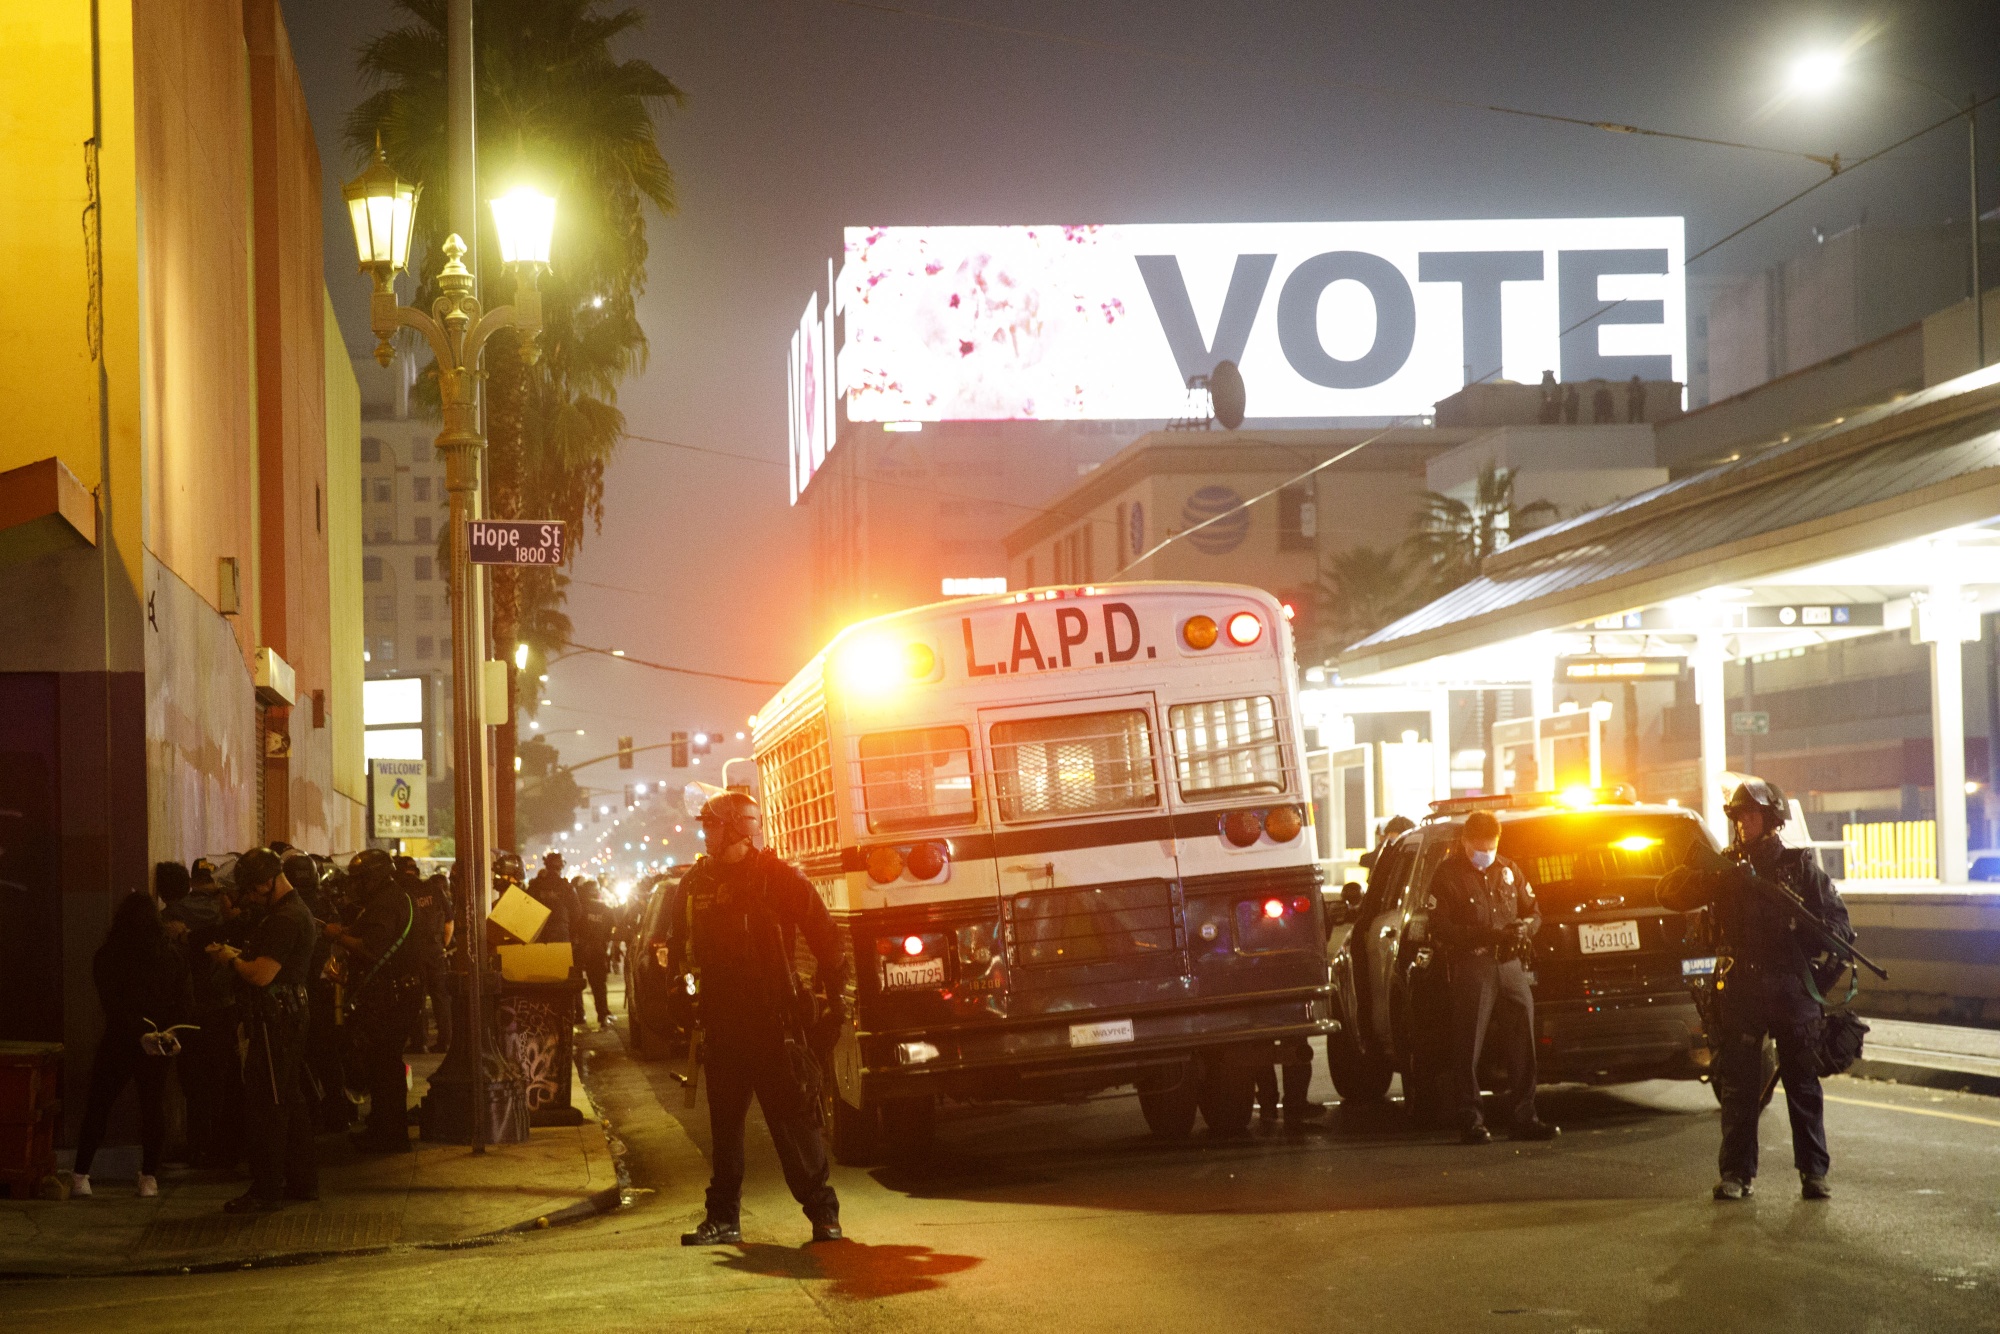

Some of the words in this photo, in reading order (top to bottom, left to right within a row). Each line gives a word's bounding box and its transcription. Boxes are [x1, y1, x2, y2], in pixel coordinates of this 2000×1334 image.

[1135, 249, 1672, 389] VOTE
[473, 524, 519, 551] Hope
[540, 525, 561, 547] St
[515, 547, 546, 563] 1800
[552, 547, 560, 563] S
[961, 603, 1157, 676] L.A.P.D.
[1585, 932, 1635, 949] 1463101
[890, 967, 942, 988] 1047795
[1092, 1027, 1127, 1038] WAYNE
